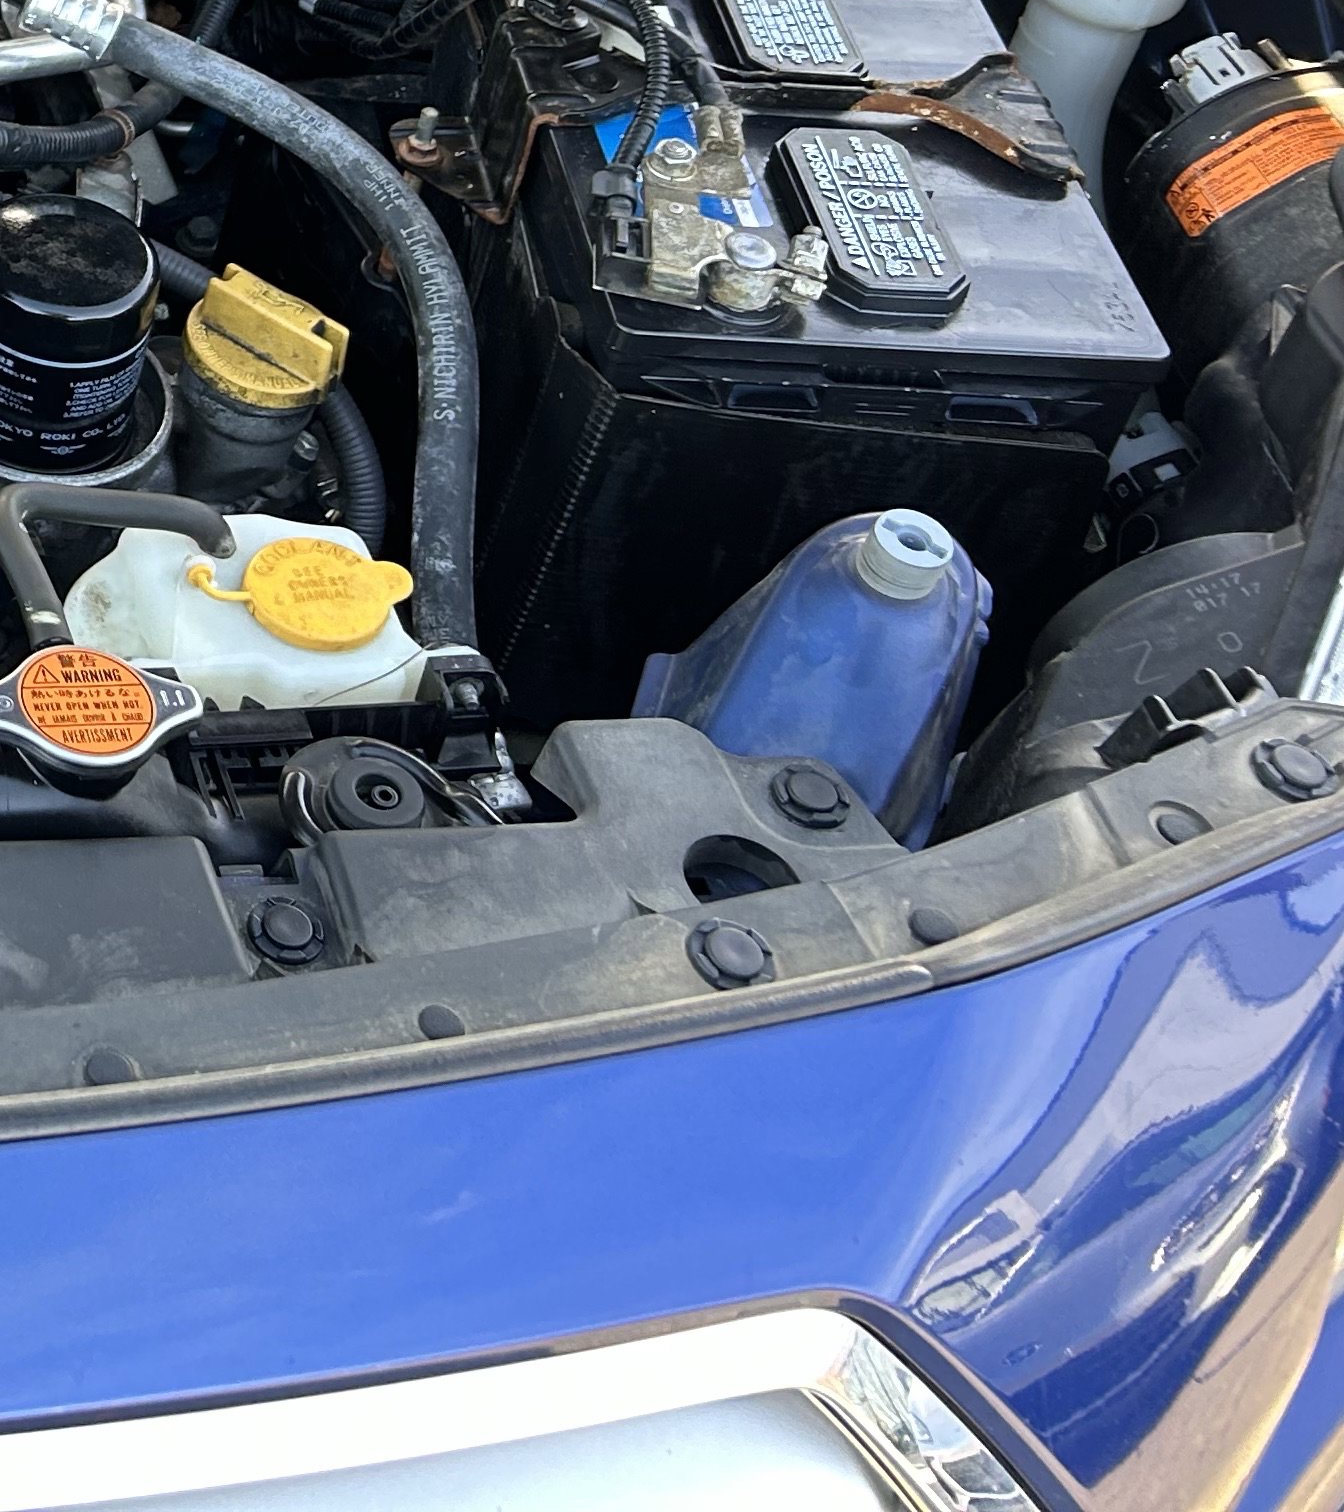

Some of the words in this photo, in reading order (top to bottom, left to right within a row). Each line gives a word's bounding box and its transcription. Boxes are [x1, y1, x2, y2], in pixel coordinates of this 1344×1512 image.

[801, 143, 836, 190] POISON
[828, 201, 865, 256] DANGER
[40, 432, 76, 441] ROKI
[61, 668, 122, 685] WARNING
[32, 702, 62, 713] NEVER
[65, 701, 90, 711] OPEN
[92, 700, 120, 711] WHEN
[62, 726, 134, 744] AVERTISSMENT
